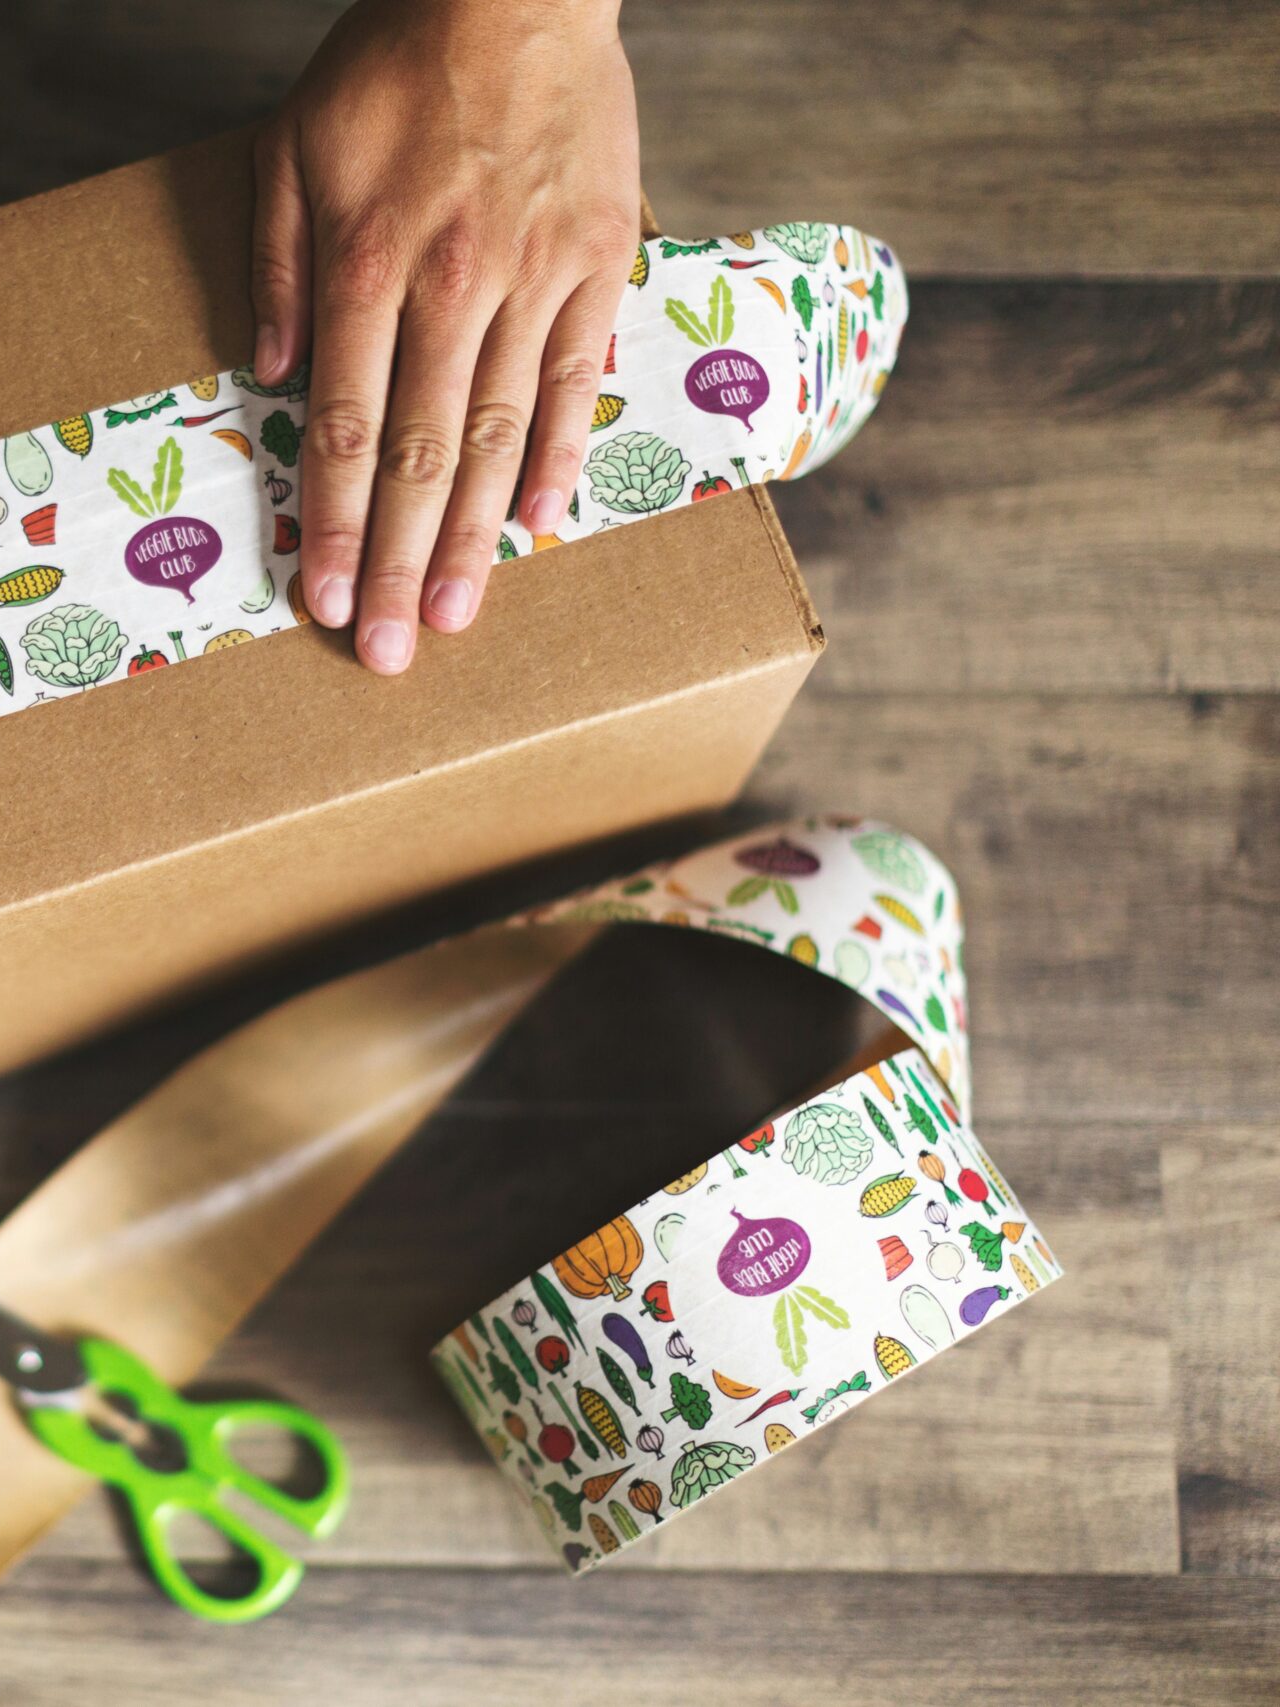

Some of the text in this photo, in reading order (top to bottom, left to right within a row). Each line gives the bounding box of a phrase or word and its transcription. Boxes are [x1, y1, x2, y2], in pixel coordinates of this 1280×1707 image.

[694, 358, 760, 392] VEGGIE BUDS
[720, 386, 753, 407] CLUB
[134, 526, 208, 564] VEGGIE BUDS
[160, 554, 196, 579] CLUB
[738, 1227, 775, 1258] CLUB
[732, 1238, 802, 1288] VEGGIE BUDS
